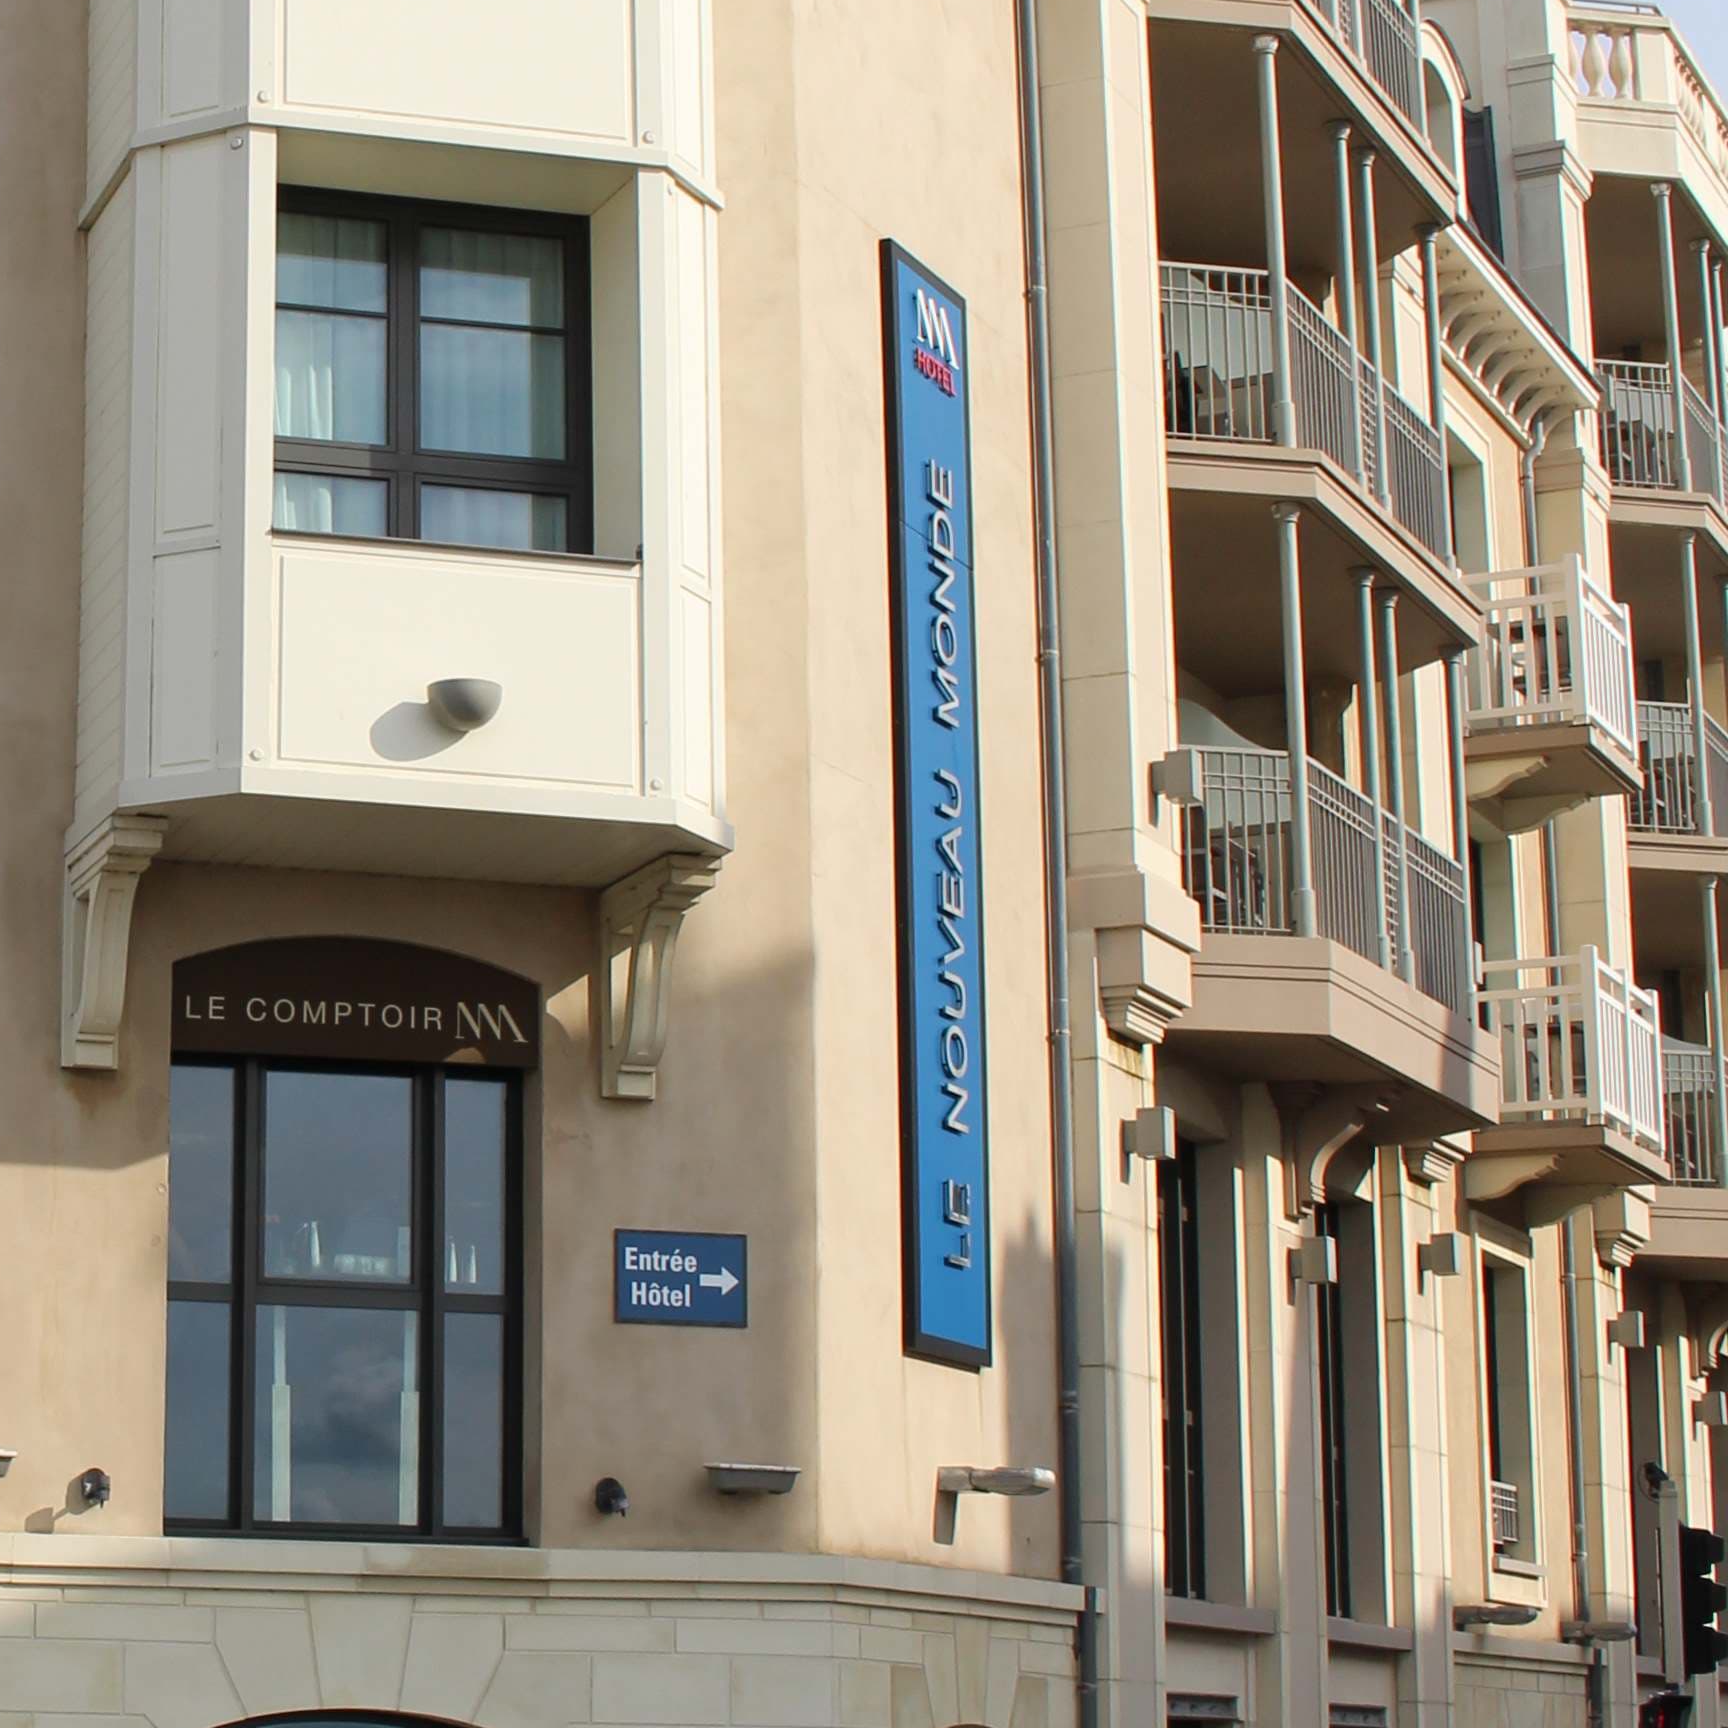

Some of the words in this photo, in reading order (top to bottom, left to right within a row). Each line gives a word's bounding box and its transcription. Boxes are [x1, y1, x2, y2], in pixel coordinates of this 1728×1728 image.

[915, 346, 957, 397] HOTEL
[929, 458, 961, 730] MONDE
[937, 767, 970, 1134] NOUVEAU
[185, 995, 226, 1020] LE
[246, 997, 443, 1031] COMPTOIR
[943, 1178, 972, 1270] LE
[624, 1246, 698, 1273] Entrée
[631, 1281, 692, 1308] Hôtel
